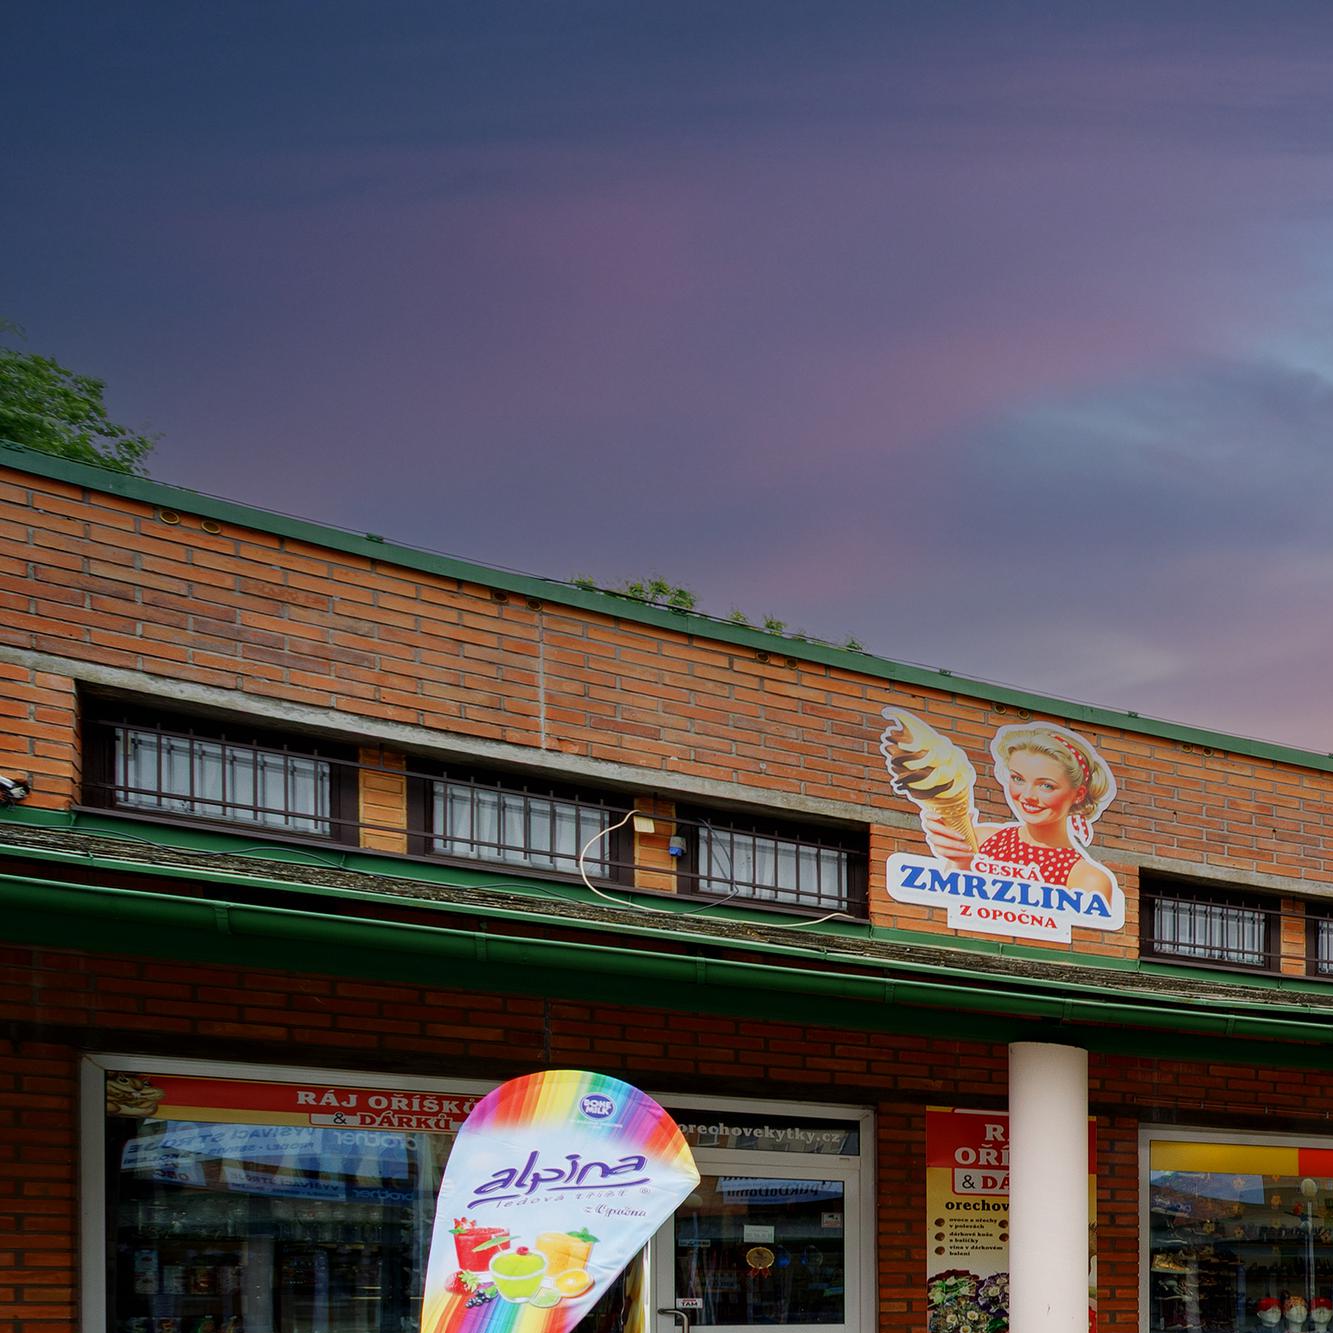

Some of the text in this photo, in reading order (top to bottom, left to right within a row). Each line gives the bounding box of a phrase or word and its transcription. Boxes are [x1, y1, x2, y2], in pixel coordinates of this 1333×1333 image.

[975, 858, 1040, 881] ČESKÁ
[900, 864, 1112, 918] ZMRZLINA
[960, 904, 1057, 929] Z OPOČNA
[296, 1089, 357, 1107] RÁJ
[333, 1111, 453, 1130] & DÁRKŮ
[679, 1122, 842, 1144] orechovekytky.cz
[954, 1144, 1009, 1166] OŘÍ
[472, 1150, 650, 1197] alpina
[962, 1173, 1009, 1190] & DÁ
[945, 1200, 1009, 1212] orechov
